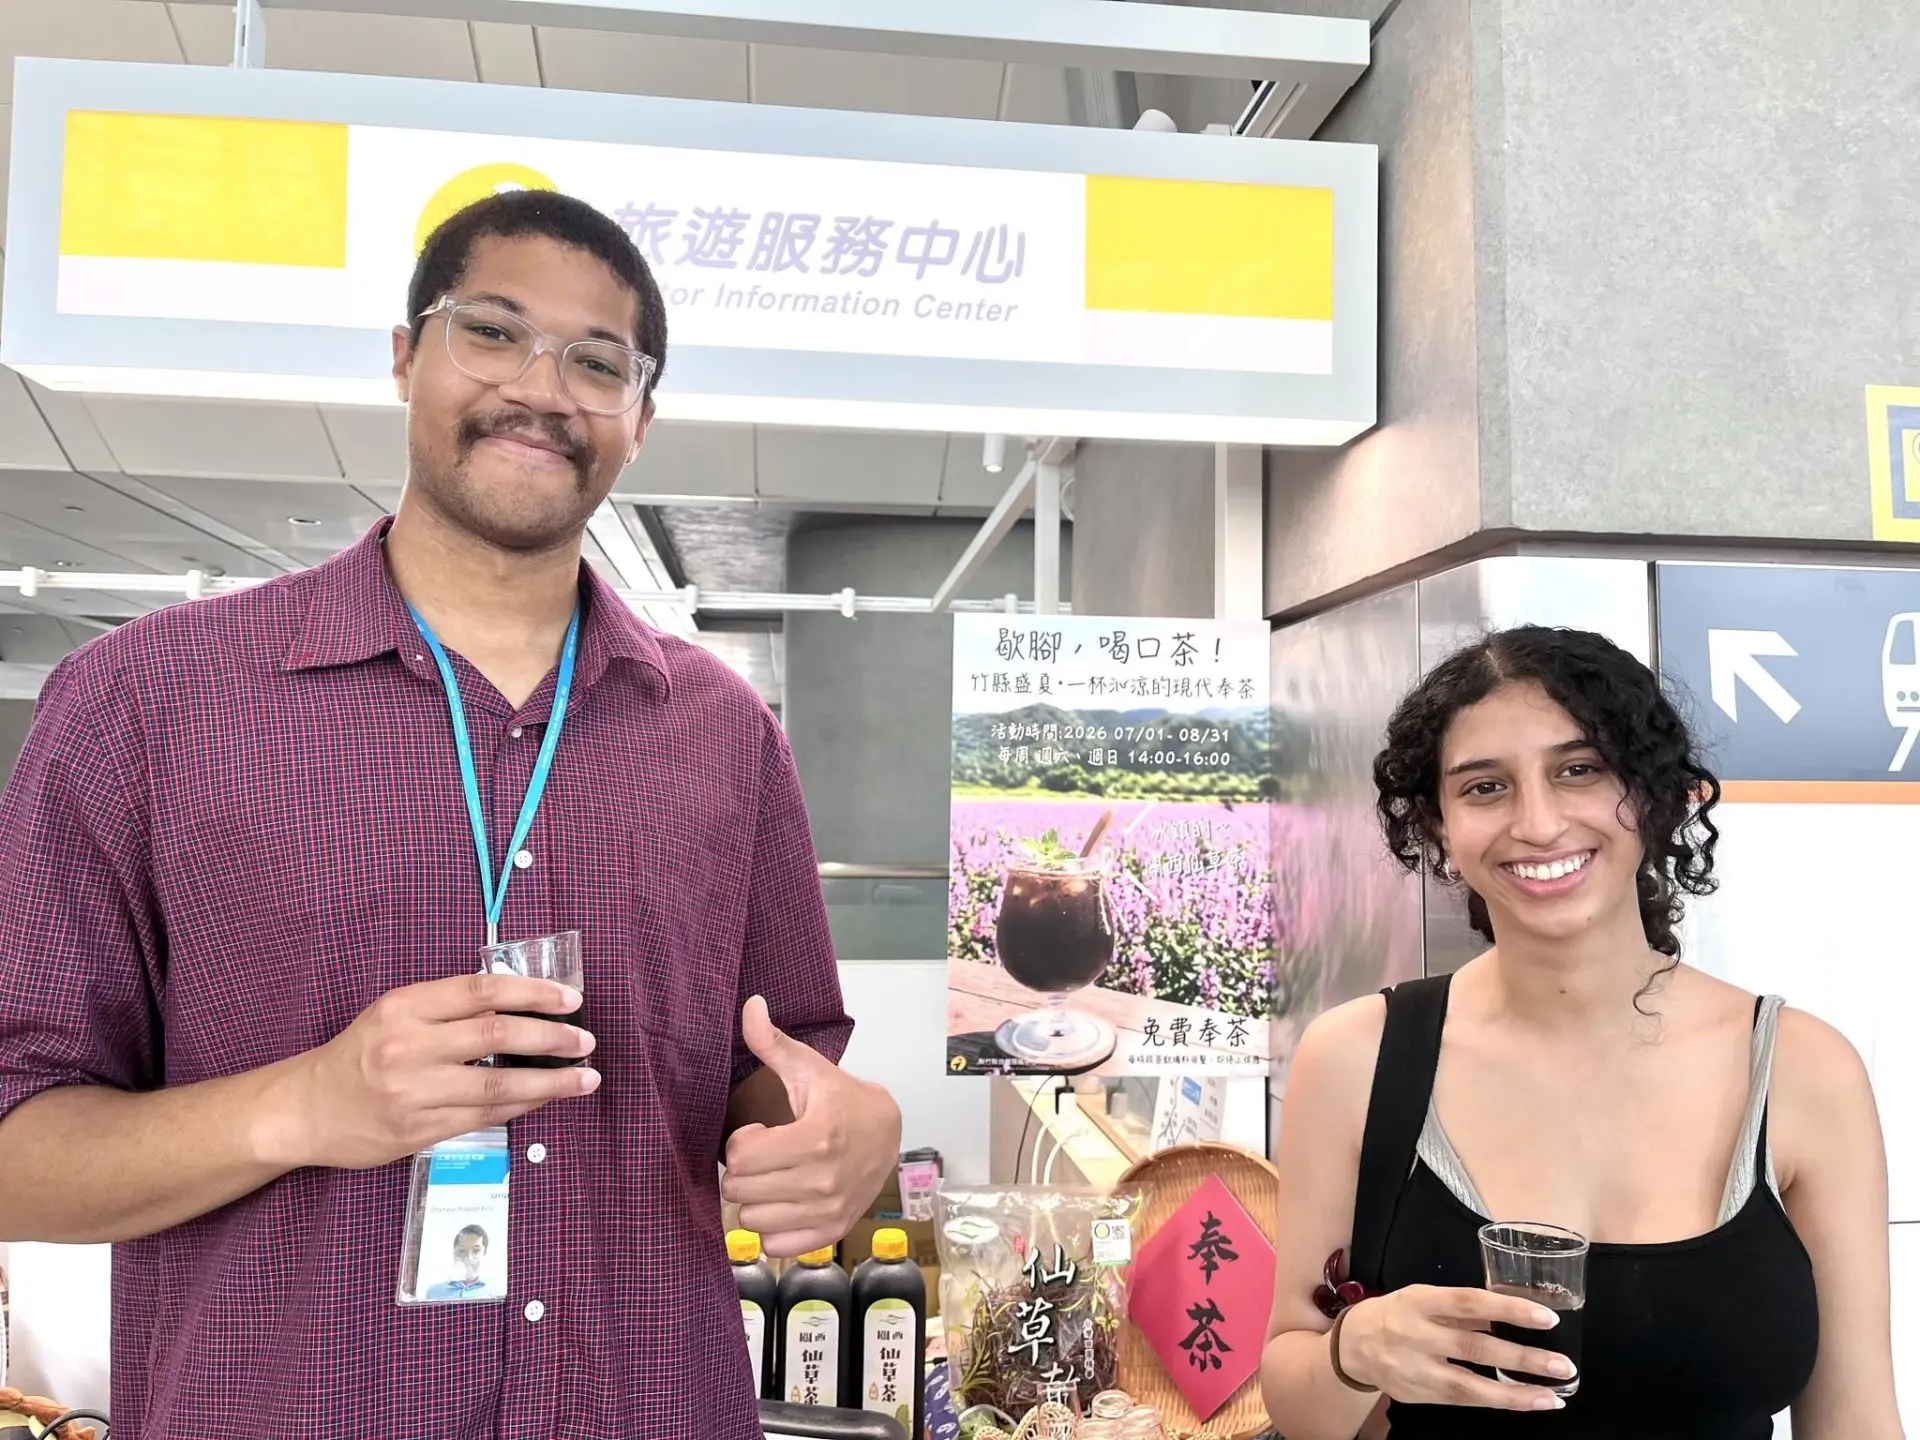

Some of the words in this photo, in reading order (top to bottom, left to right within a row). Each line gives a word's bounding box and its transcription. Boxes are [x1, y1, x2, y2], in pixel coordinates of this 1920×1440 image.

[613, 201, 1026, 284] 旅遊服務中心
[713, 283, 900, 317] Information
[913, 294, 1018, 322] Center
[1179, 727, 1229, 744] 08/31
[1128, 750, 1230, 766] 14:00-16:00
[1142, 1016, 1250, 1047] 免費奉茶
[1178, 1210, 1239, 1373] 奉茶
[880, 1346, 901, 1402] 仙草茶
